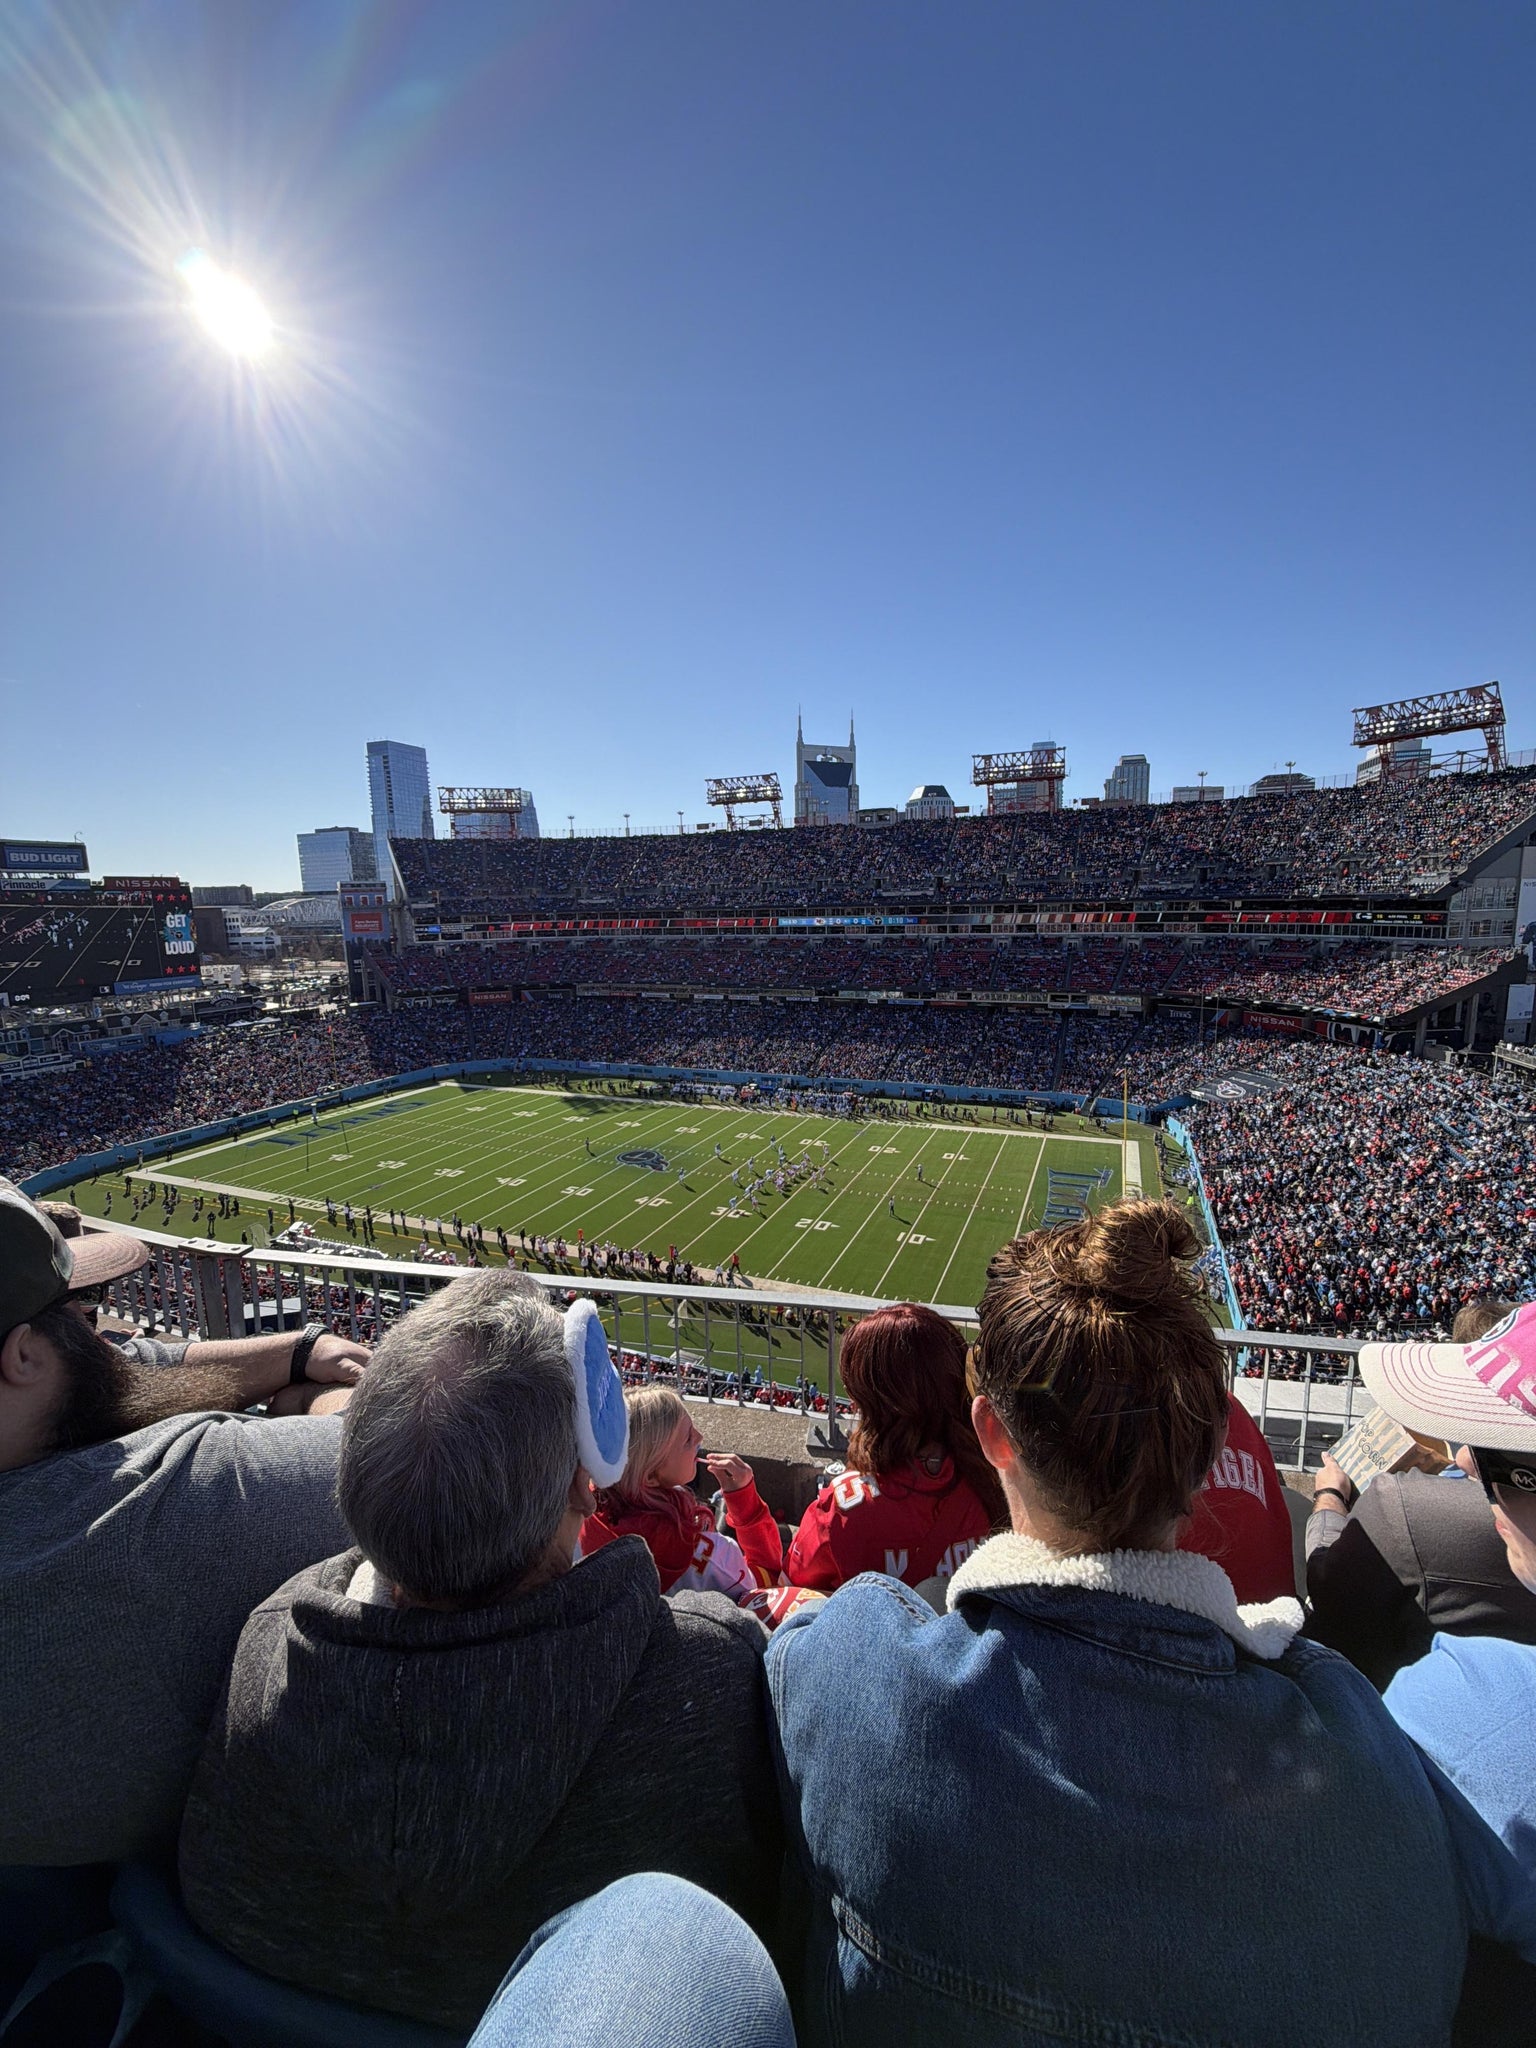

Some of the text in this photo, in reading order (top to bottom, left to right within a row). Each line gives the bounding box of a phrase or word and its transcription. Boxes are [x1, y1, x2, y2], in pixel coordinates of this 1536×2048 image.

[9, 852, 79, 864] BUD LIGHT
[3, 880, 46, 890] Pinnacle
[115, 879, 172, 888] NISSAN
[165, 914, 187, 928] GET
[164, 940, 195, 955] LOUD
[201, 966, 235, 975] ISSAN
[1250, 1015, 1296, 1027] NISSAN
[561, 1186, 595, 1196] 50
[634, 1196, 664, 1207] 40
[710, 1206, 745, 1219] 30
[795, 1218, 832, 1230] 20
[897, 1231, 926, 1245] 10
[1358, 1437, 1389, 1471] CORN
[1514, 1473, 1536, 1488] MK
